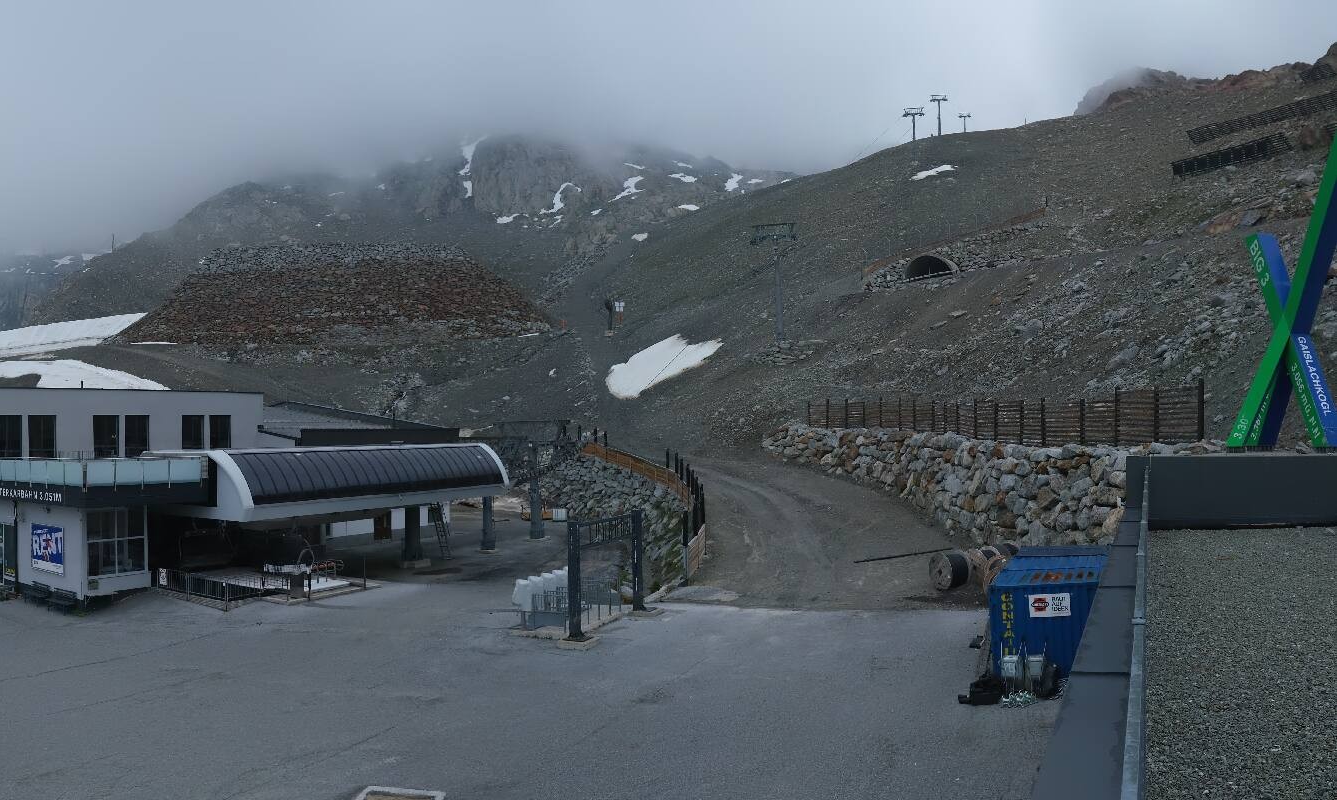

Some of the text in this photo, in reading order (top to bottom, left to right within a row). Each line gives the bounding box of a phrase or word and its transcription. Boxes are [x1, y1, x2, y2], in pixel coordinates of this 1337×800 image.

[1249, 239, 1270, 287] BIG 3
[1297, 336, 1332, 416] GAISLACHKOGL
[1233, 415, 1249, 439] 3.30
